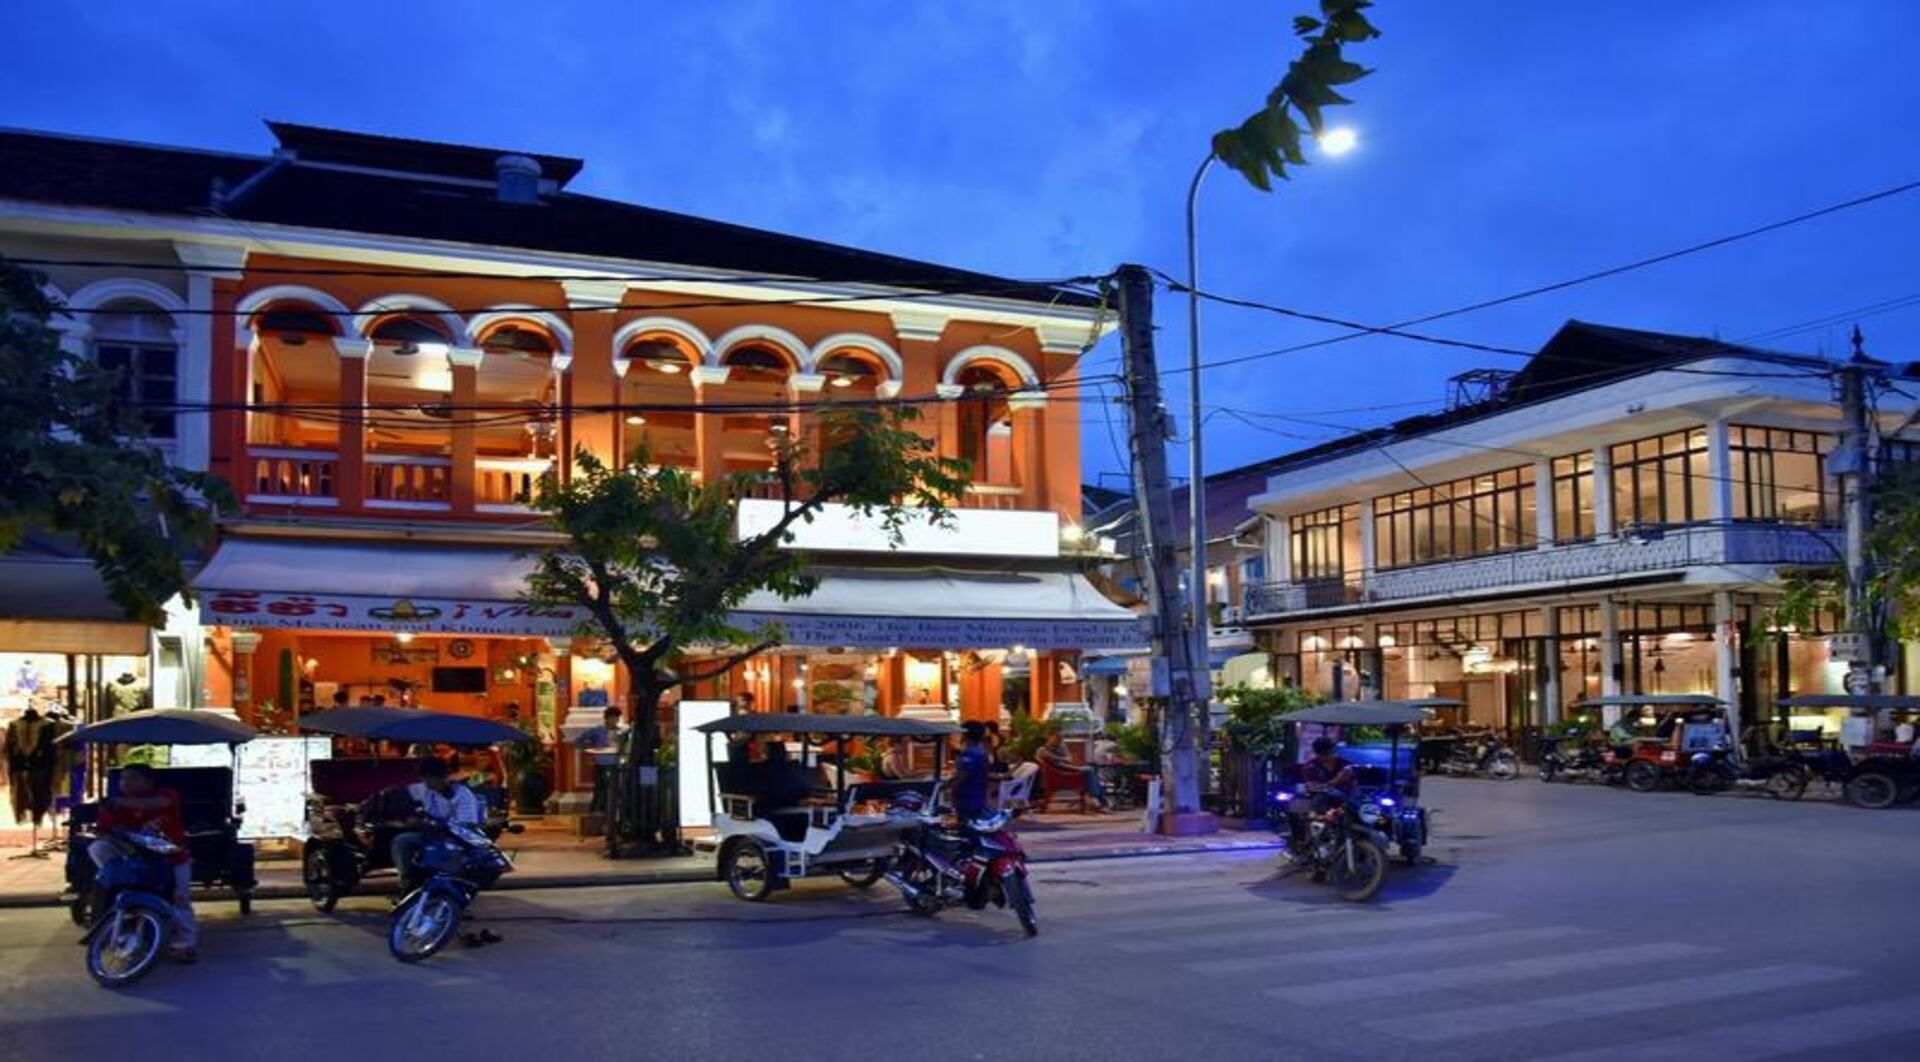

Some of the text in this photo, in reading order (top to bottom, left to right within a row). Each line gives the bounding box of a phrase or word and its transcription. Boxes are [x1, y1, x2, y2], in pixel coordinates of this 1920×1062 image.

[279, 618, 384, 631] Mexican
[388, 622, 432, 632] and
[815, 619, 865, 631] 2006
[875, 621, 911, 632] The
[965, 623, 1047, 635] Mexican
[1052, 625, 1098, 636] Food
[804, 632, 839, 642] The
